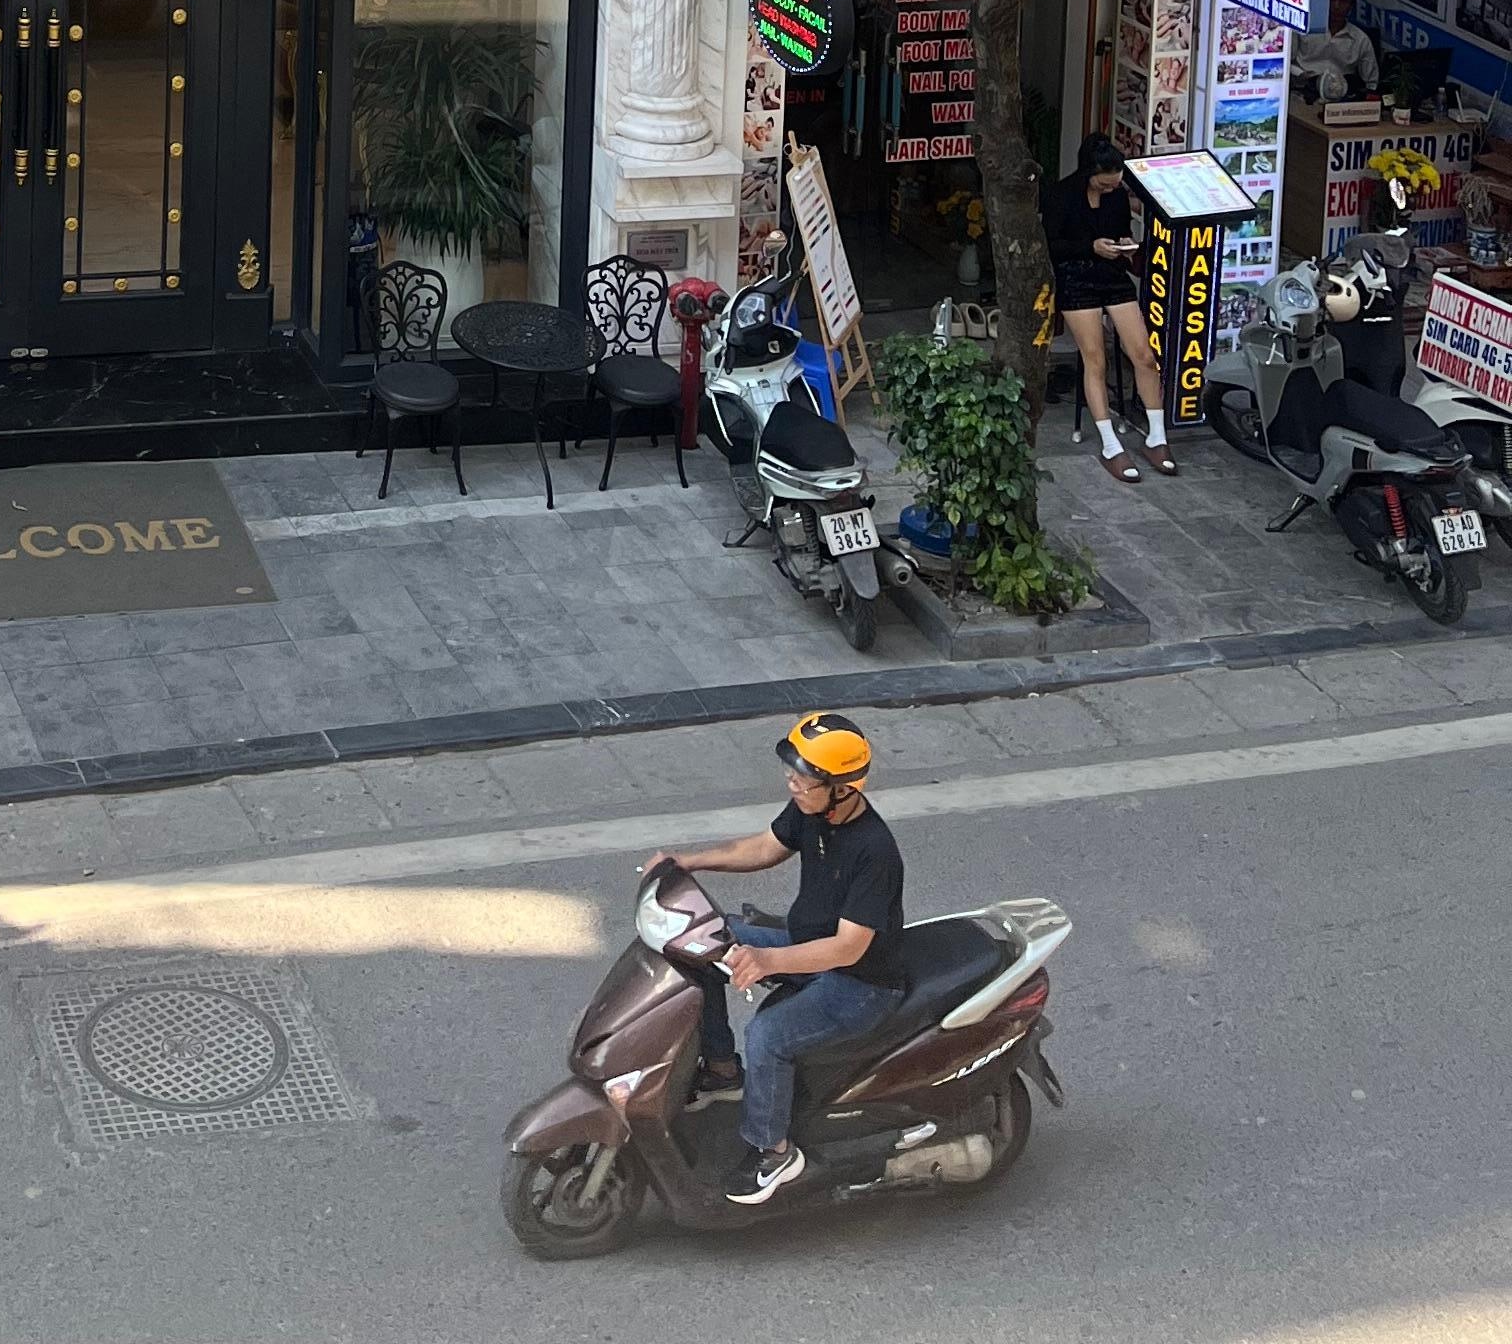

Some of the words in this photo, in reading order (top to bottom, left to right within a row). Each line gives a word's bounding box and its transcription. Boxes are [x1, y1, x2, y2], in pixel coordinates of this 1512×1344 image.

[898, 10, 942, 34] BODY
[901, 39, 942, 63] FOOT
[909, 71, 946, 94] NAIL
[932, 100, 976, 124] WAXI
[1330, 140, 1373, 172] SIM
[1443, 132, 1471, 163] 4G
[1429, 283, 1471, 327] MONEY
[1180, 226, 1214, 418] MASSAGE
[1425, 317, 1448, 344] SIM
[1449, 328, 1481, 359] CARD
[1419, 340, 1473, 387] MOTORBIKE
[1472, 364, 1491, 395] FOR
[835, 529, 872, 551] 3845
